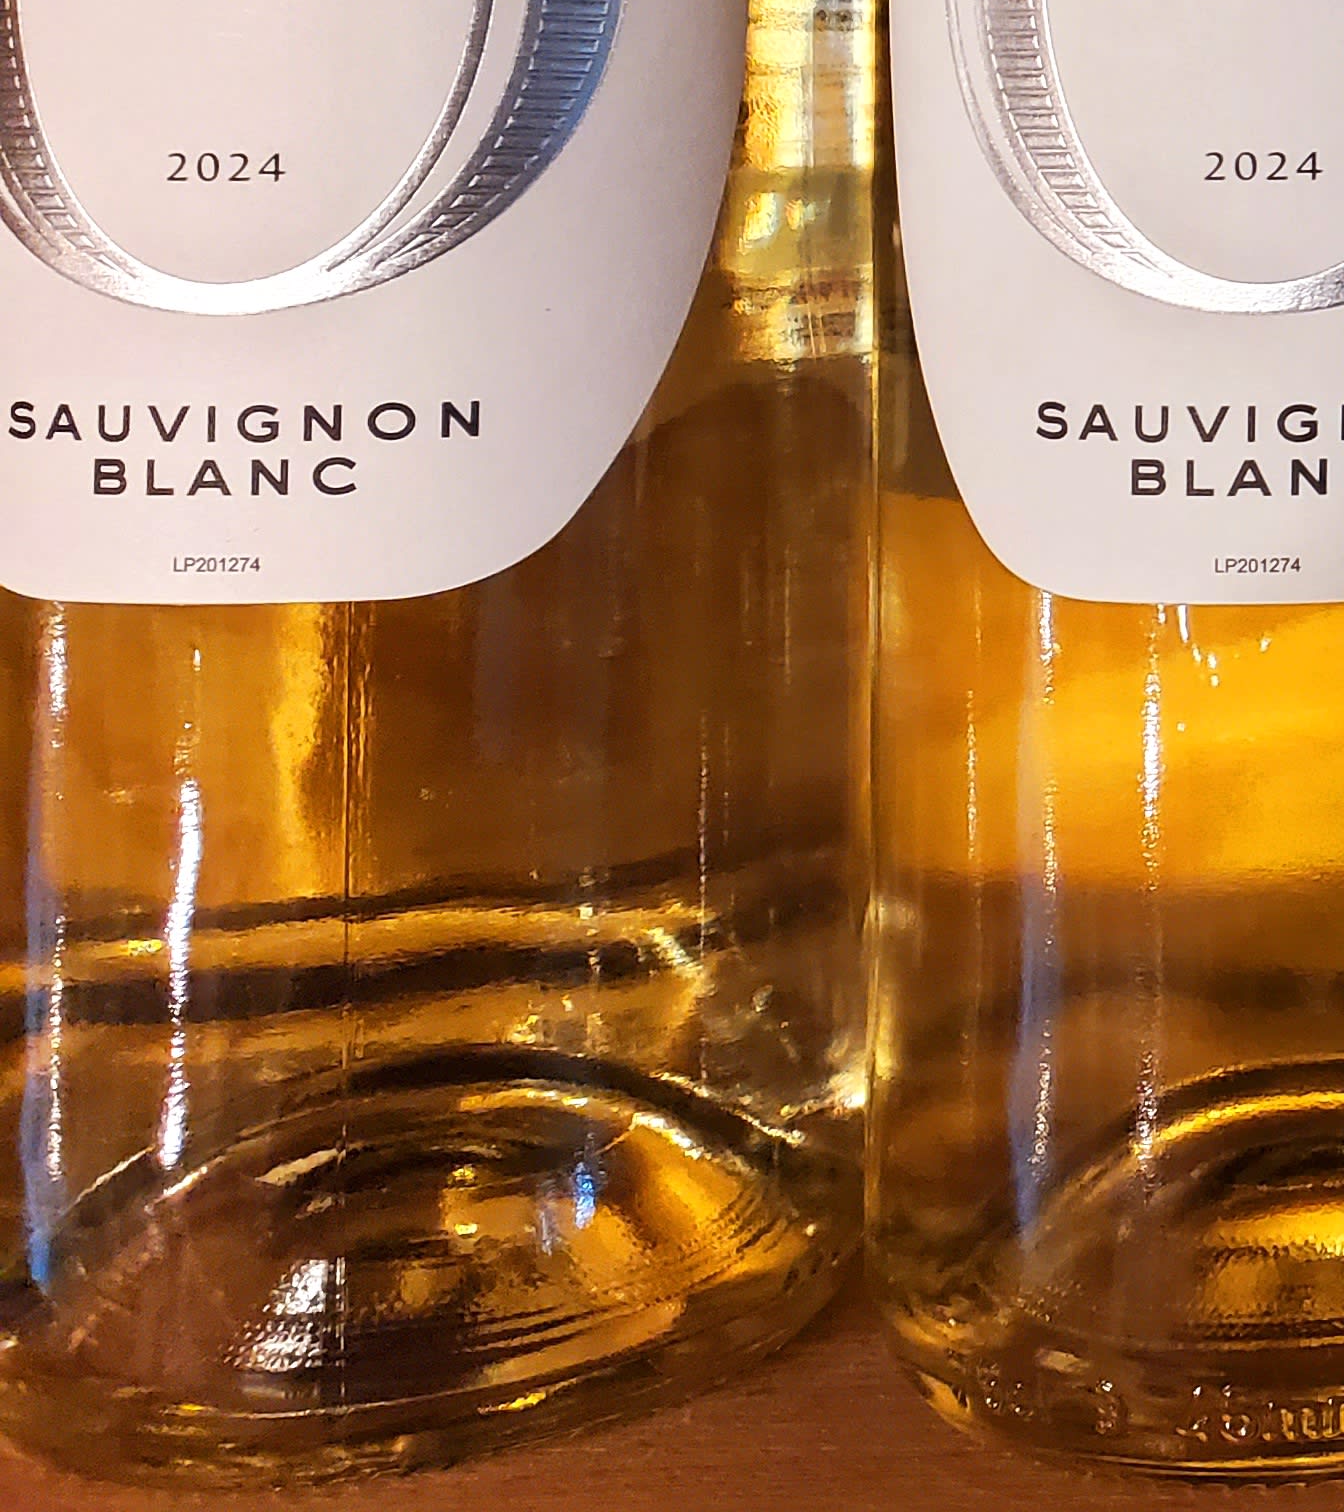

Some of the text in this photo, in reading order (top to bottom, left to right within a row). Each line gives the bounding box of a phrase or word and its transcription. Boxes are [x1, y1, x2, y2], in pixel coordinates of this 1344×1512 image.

[167, 152, 286, 182] 2024
[1204, 151, 1323, 181] 2024
[8, 400, 480, 444] SAUVIGNON
[93, 456, 357, 496] BLANC
[172, 556, 262, 574] LP201274
[1213, 556, 1302, 575] LP201274
